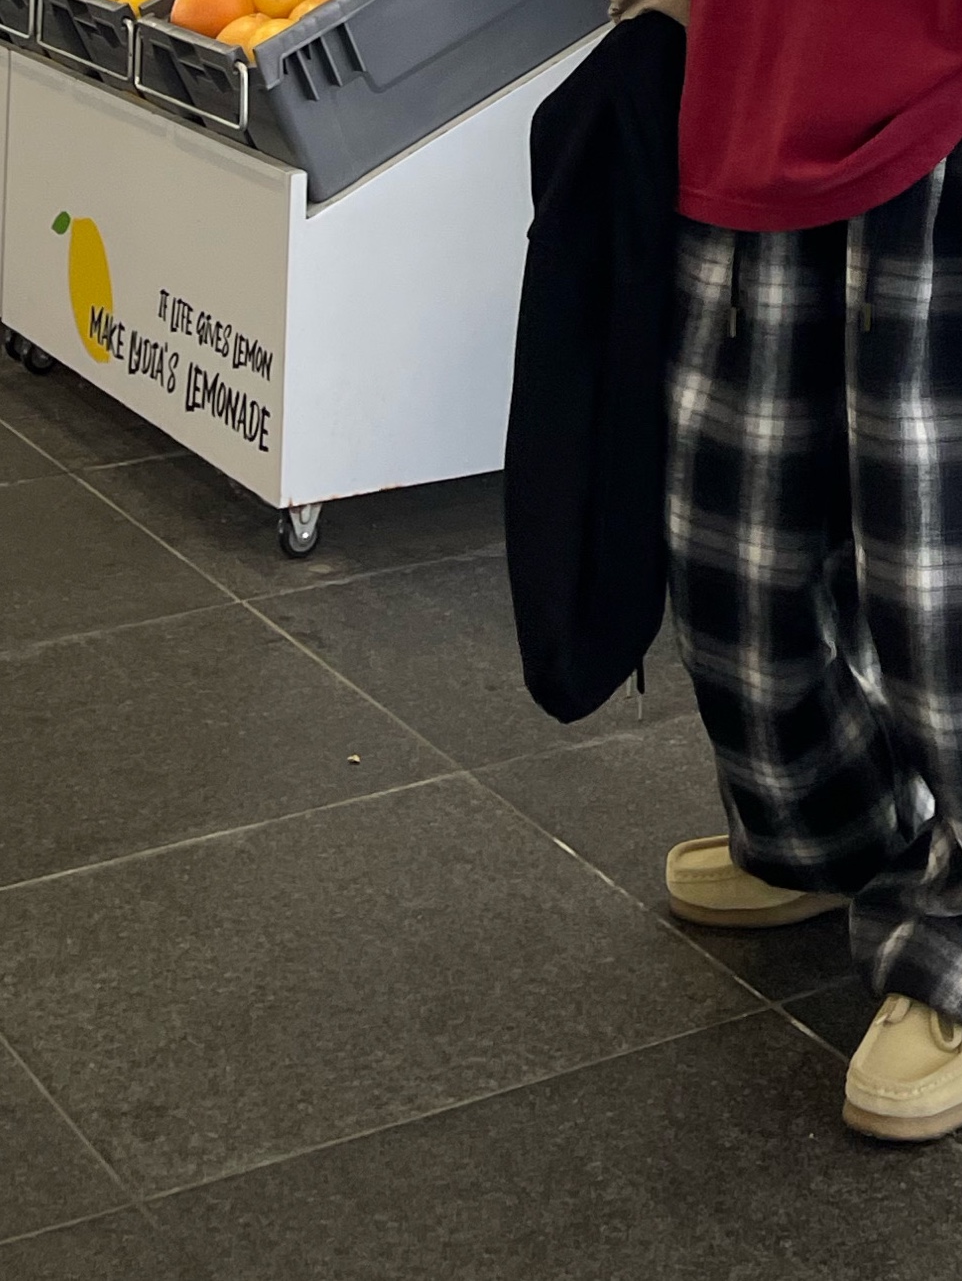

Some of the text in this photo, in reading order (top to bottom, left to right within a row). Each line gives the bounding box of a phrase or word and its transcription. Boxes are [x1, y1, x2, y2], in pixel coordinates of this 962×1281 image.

[89, 304, 271, 453] MAKE LYDIA'S LEMONADE
[196, 310, 232, 358] GIVES
[232, 332, 273, 382] LEMON
